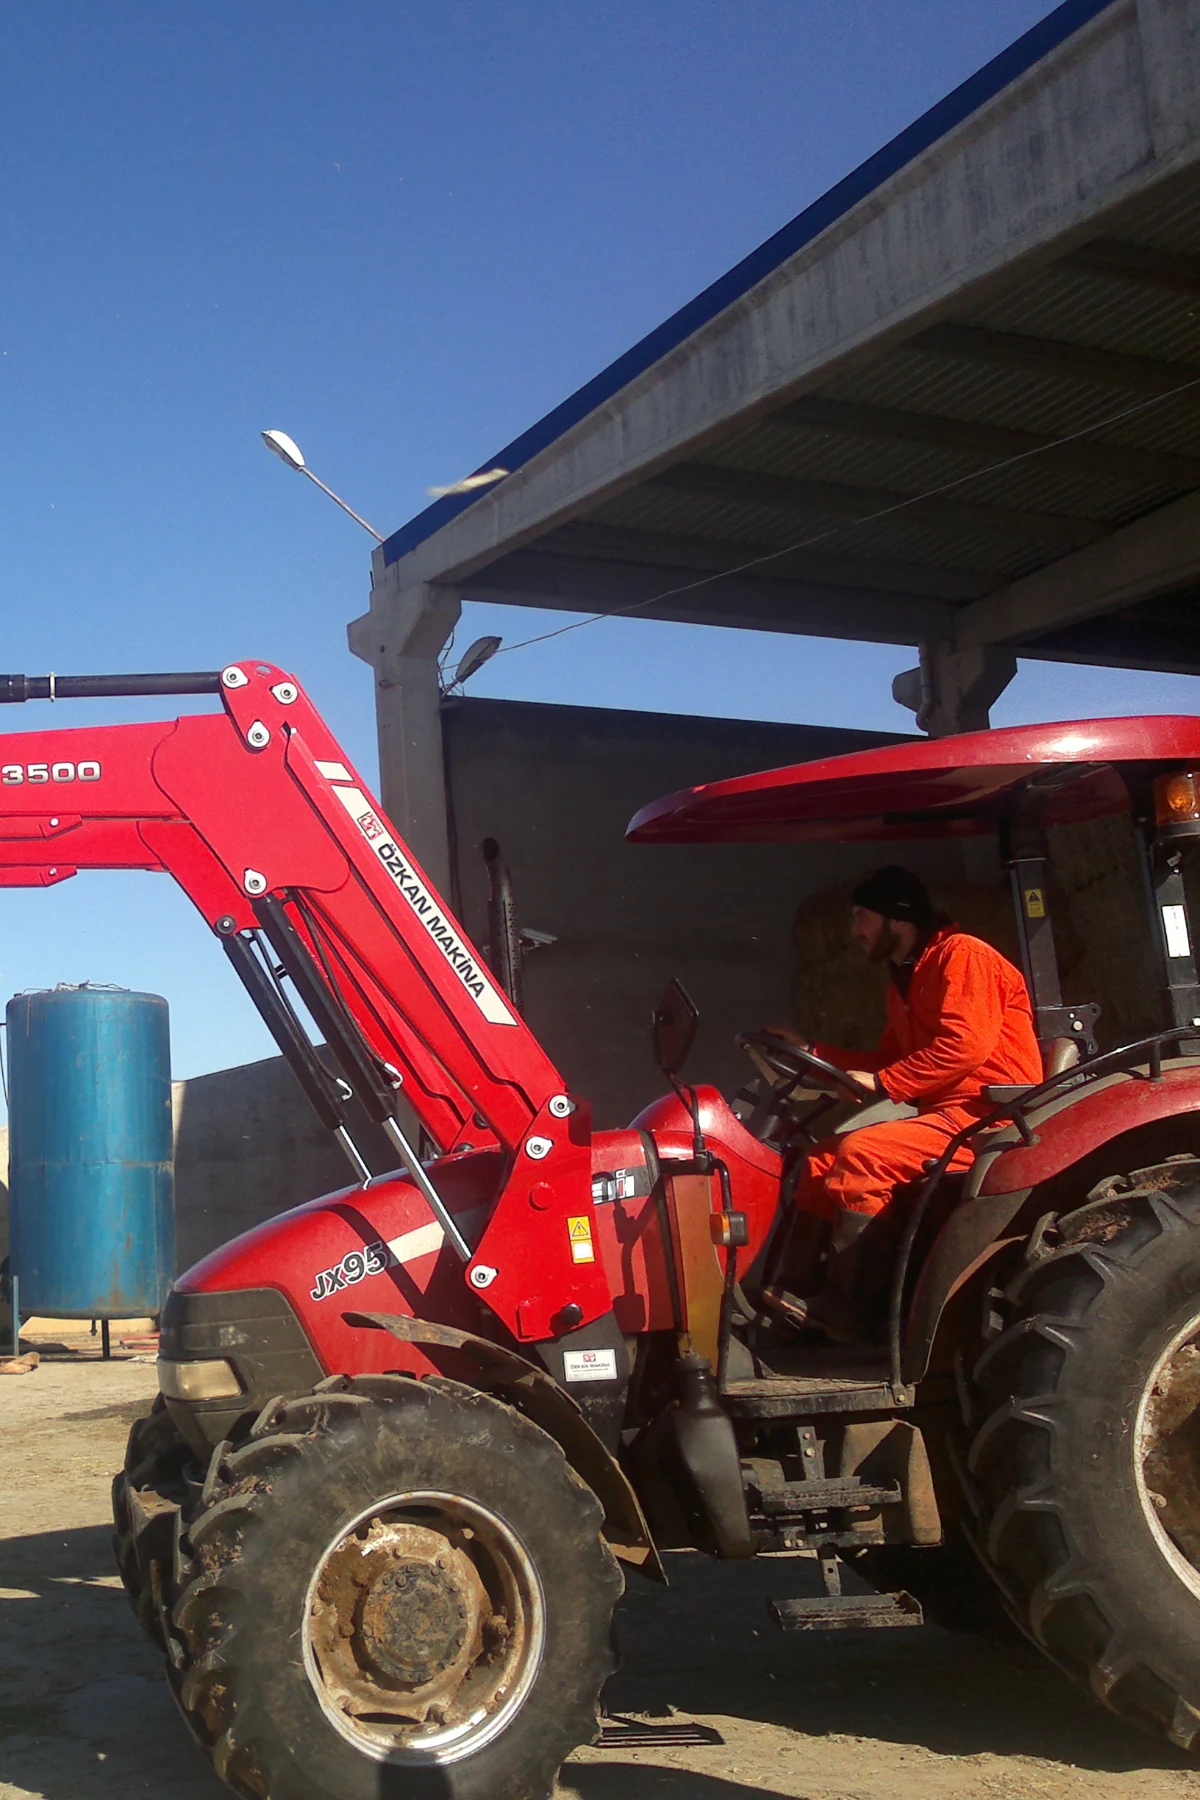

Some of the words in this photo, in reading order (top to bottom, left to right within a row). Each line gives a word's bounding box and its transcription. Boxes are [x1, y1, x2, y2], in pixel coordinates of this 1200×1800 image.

[1, 760, 102, 785] 3500
[378, 843, 432, 915] ÖZKAN
[426, 916, 485, 998] MAKİNA
[310, 1240, 388, 1302] JX95
